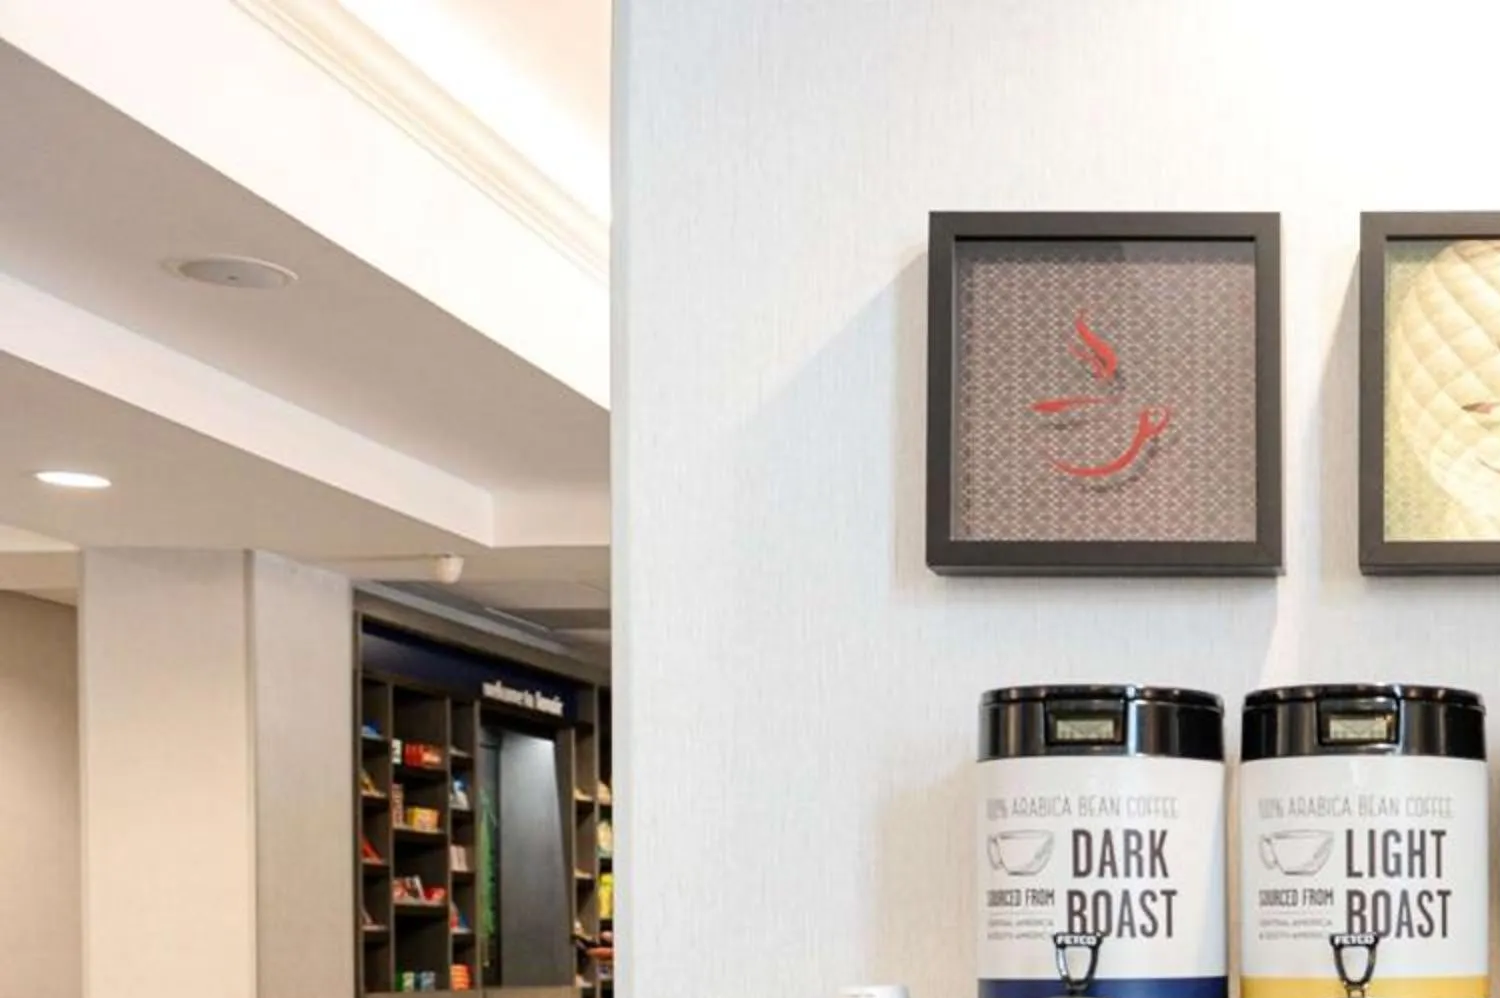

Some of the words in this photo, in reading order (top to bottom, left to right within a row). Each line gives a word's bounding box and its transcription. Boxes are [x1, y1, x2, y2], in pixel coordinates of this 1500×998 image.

[1072, 828, 1169, 879] DARK
[1345, 828, 1447, 879] LIGHT
[1066, 888, 1178, 939] ROAST
[1302, 887, 1335, 907] FROM
[1346, 888, 1453, 939] ROAST
